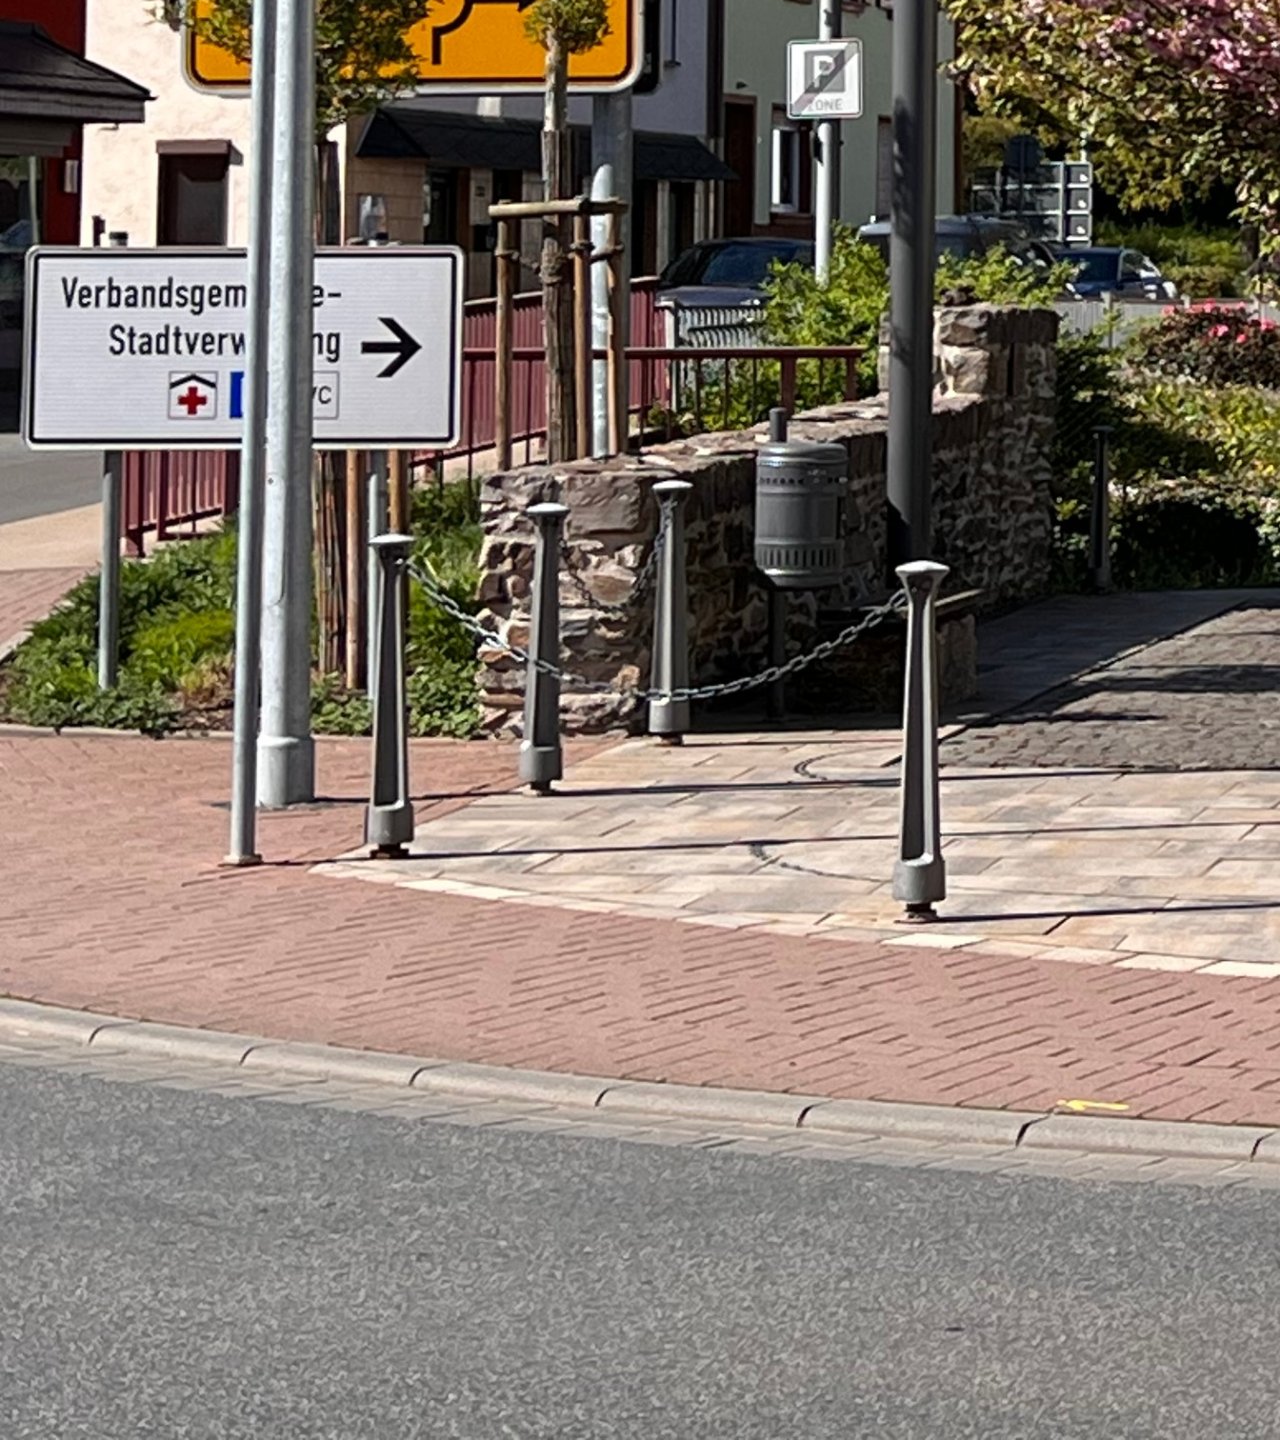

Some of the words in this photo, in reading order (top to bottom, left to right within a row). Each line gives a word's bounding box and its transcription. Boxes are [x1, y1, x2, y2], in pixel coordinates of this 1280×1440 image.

[62, 277, 342, 316] Verbandsgeme-
[109, 324, 341, 363] Stadtverwng
[312, 385, 332, 405] C
